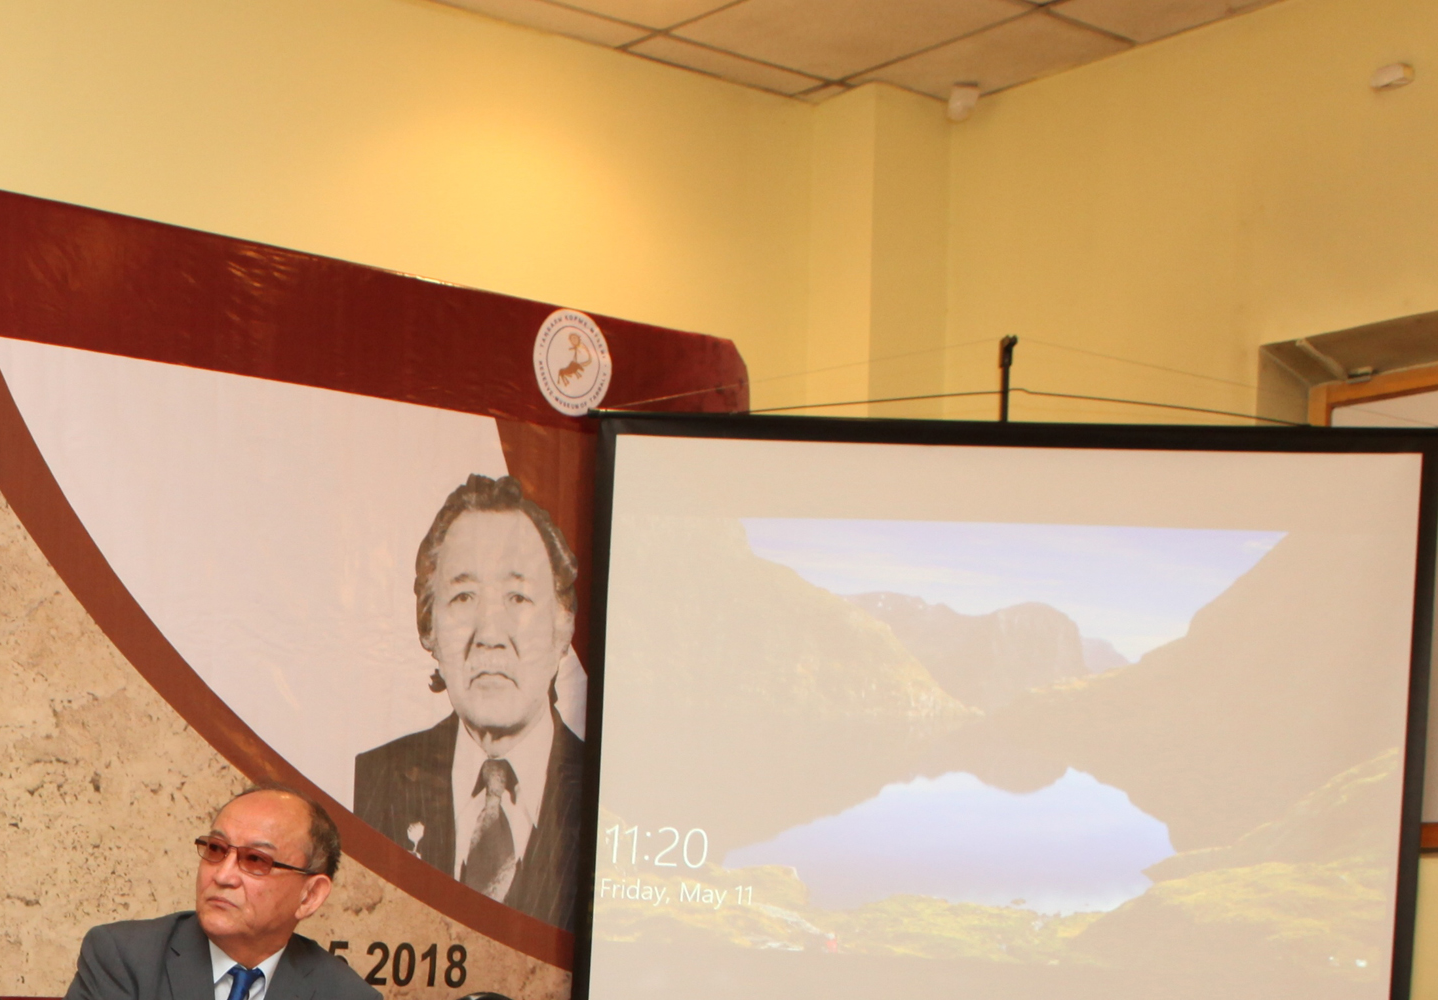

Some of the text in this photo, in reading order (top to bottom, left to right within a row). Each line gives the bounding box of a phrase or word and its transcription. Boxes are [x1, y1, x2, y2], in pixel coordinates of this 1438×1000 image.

[605, 824, 709, 869] 11:20
[599, 877, 754, 910] Friday, May 11
